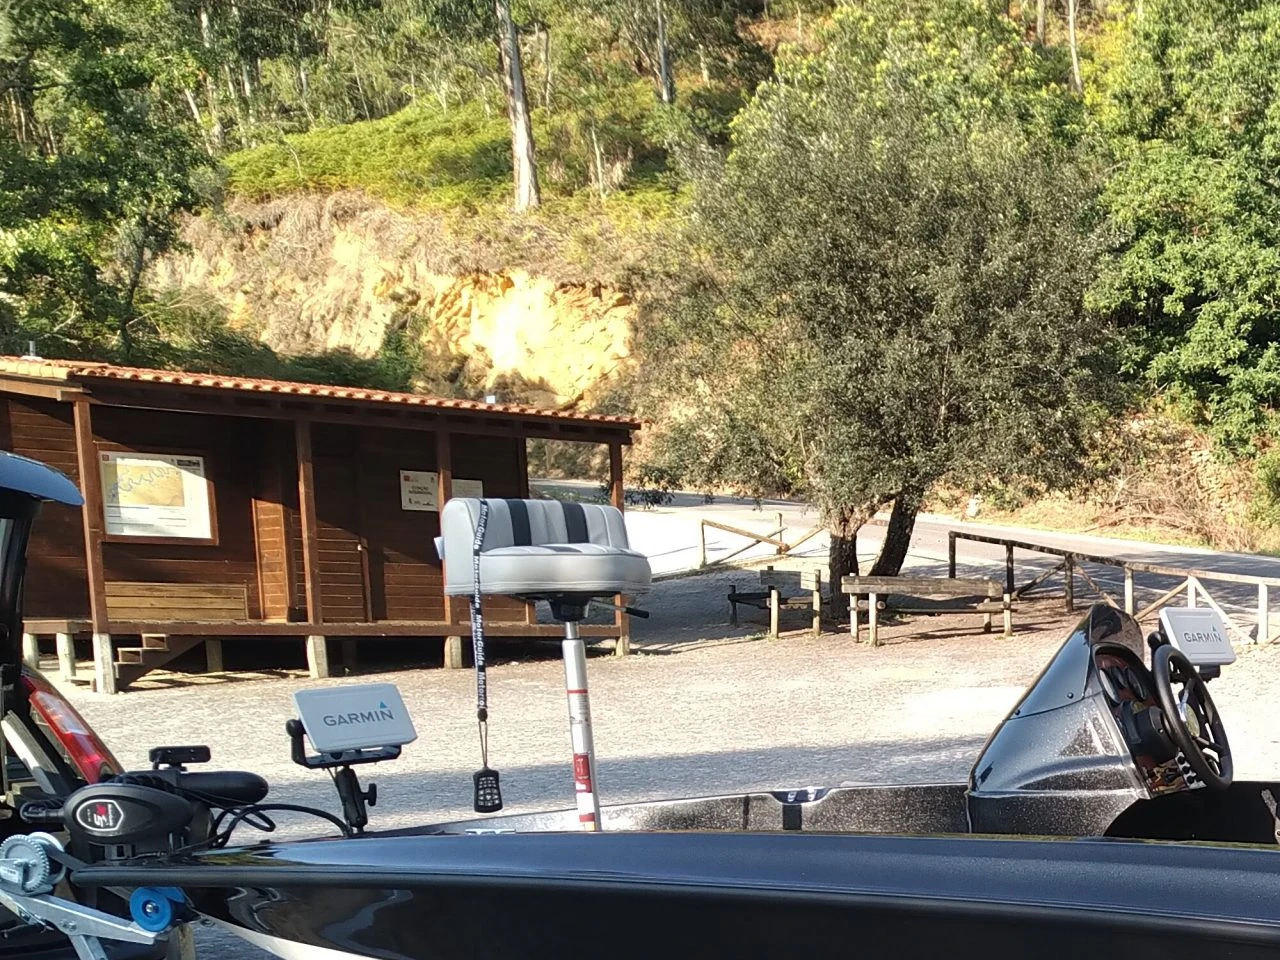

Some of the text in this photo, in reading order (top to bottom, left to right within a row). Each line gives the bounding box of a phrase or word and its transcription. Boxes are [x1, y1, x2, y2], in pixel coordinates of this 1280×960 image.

[474, 503, 489, 550] MotorGuide
[476, 614, 486, 667] MotorGuide
[1183, 632, 1222, 643] GARMIN
[323, 709, 395, 727] GARMIN
